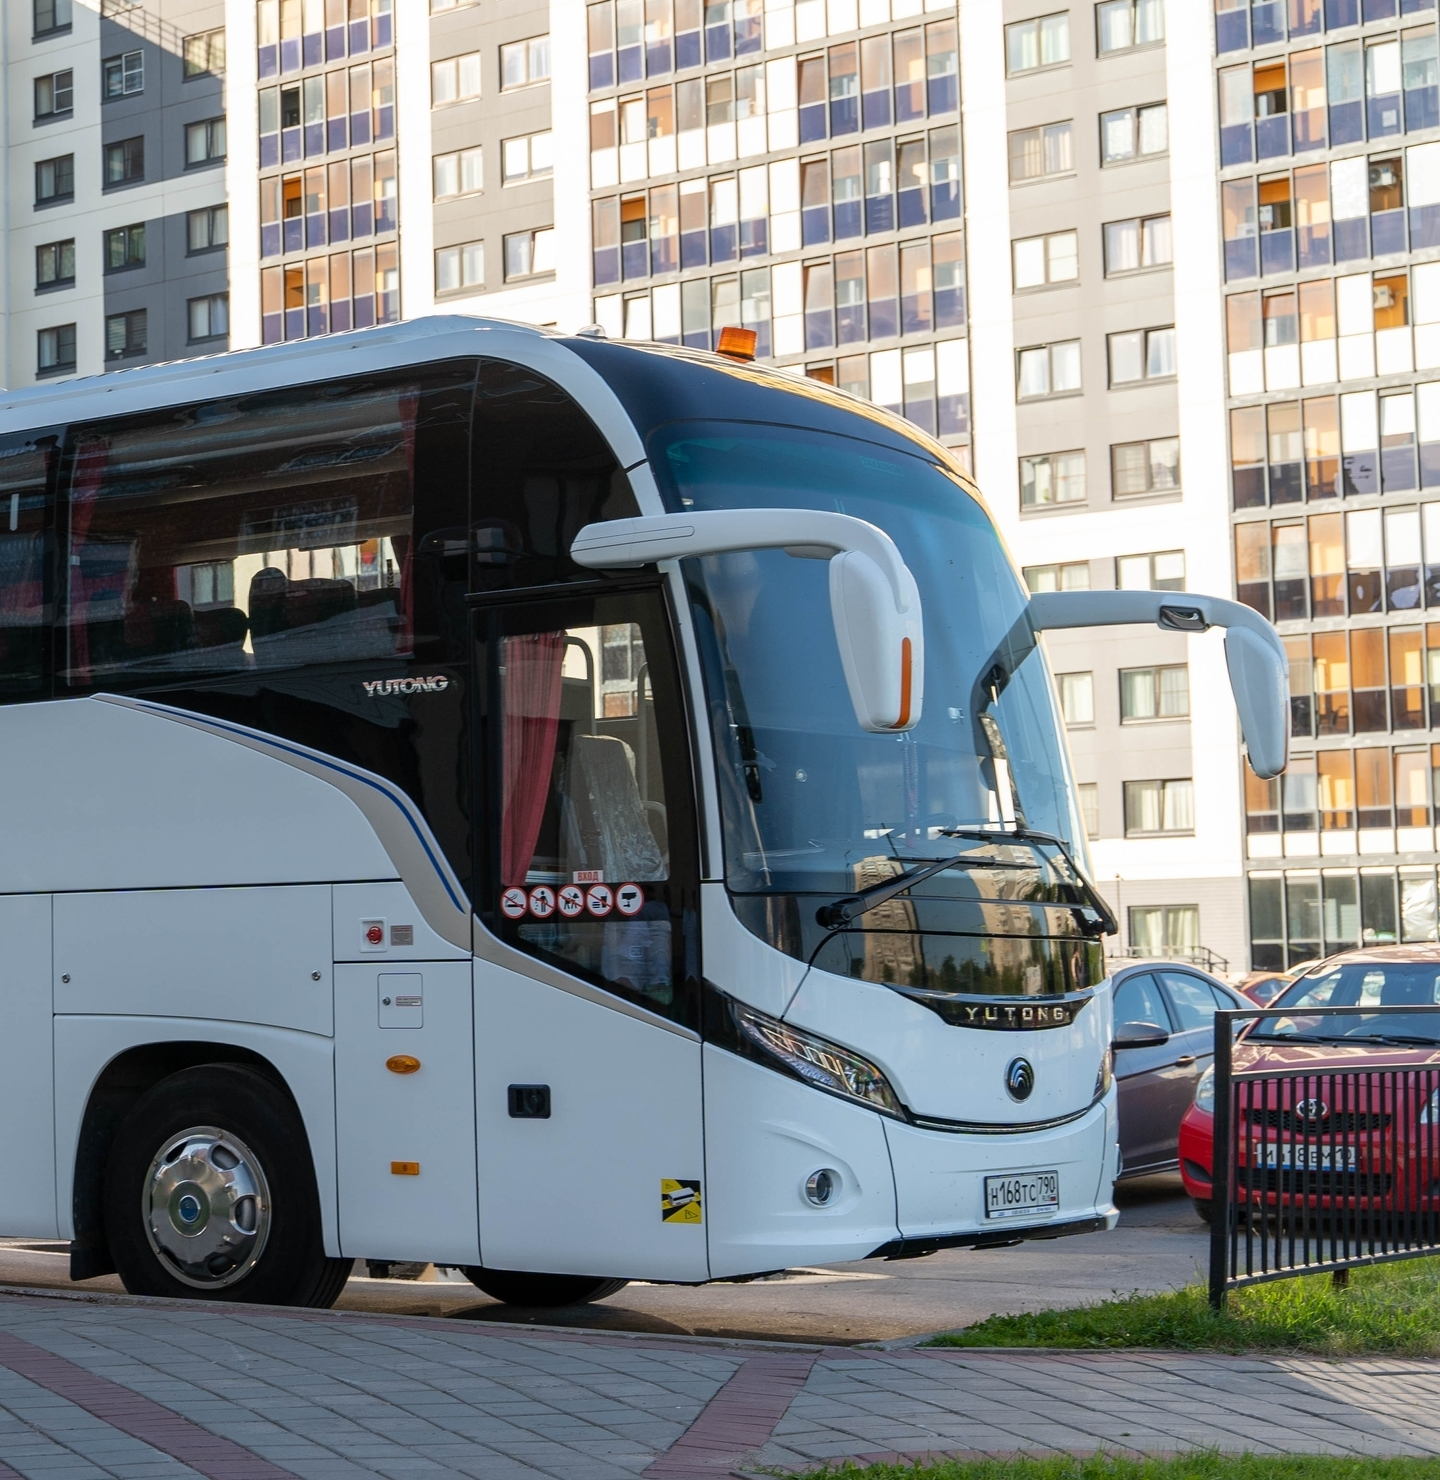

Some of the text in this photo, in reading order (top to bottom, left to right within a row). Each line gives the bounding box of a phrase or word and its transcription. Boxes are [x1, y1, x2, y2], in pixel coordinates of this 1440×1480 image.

[362, 675, 449, 697] YUTONG
[577, 871, 599, 882] ВХОД
[964, 1007, 1064, 1021] YUTONG
[1037, 1175, 1056, 1195] 790
